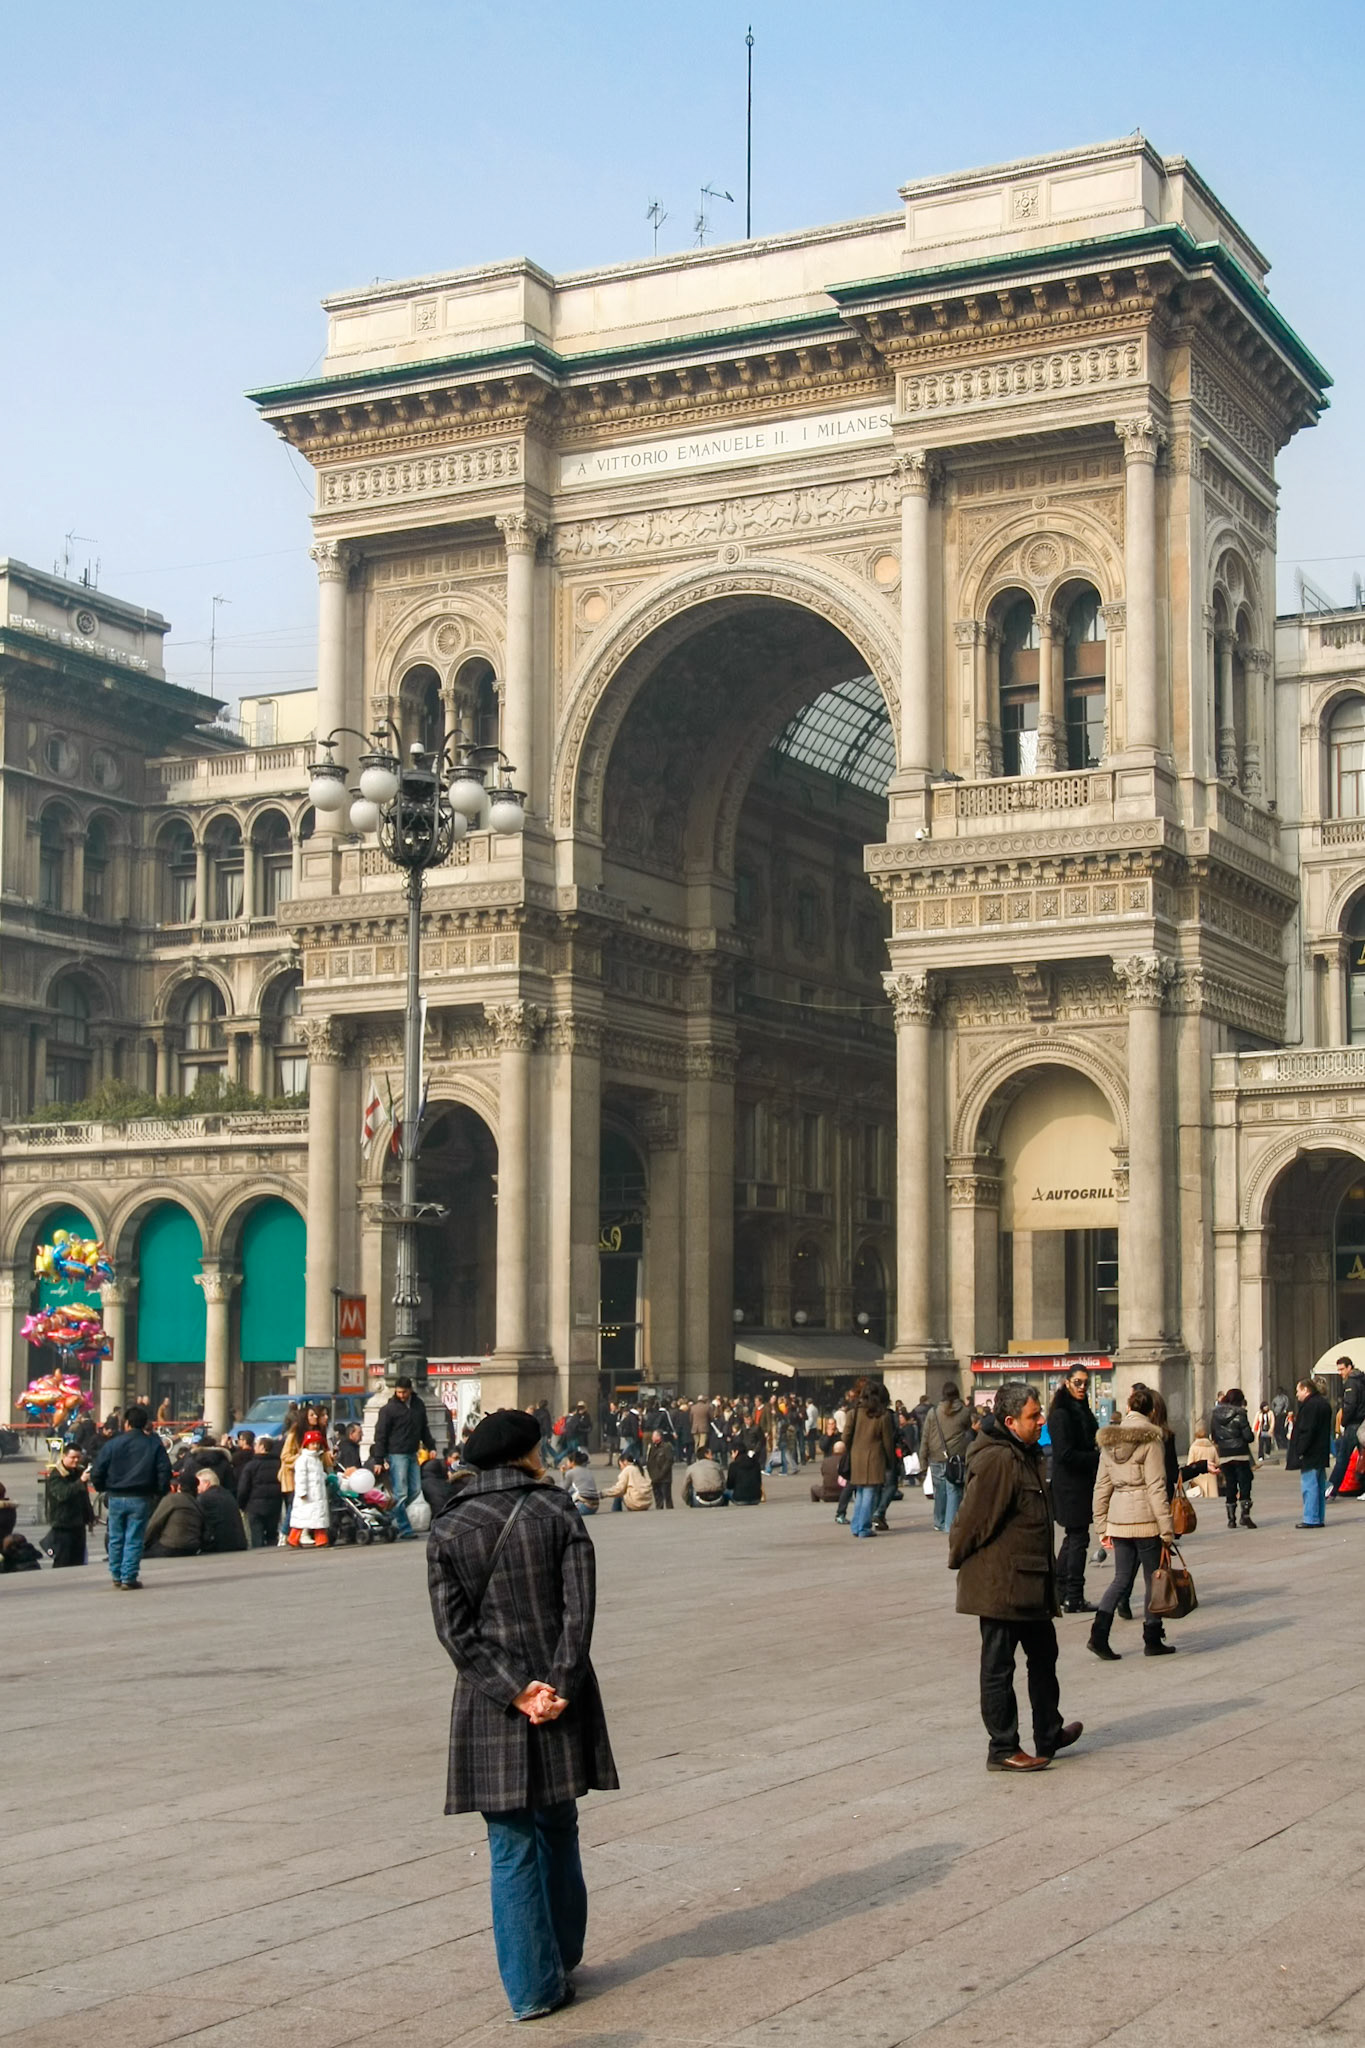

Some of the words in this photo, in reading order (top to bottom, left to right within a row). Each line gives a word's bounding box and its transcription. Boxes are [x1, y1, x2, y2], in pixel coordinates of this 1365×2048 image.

[577, 463, 587, 476] A
[597, 450, 668, 472] VITTORIO
[677, 433, 765, 460] EMANUELE
[817, 413, 893, 438] MILANESI
[1045, 1188, 1114, 1201] AUTOGRILL
[341, 1303, 364, 1331] M
[436, 1364, 450, 1373] The
[983, 1359, 990, 1369] la
[991, 1358, 1030, 1370] Repubblica
[1053, 1358, 1060, 1367] la
